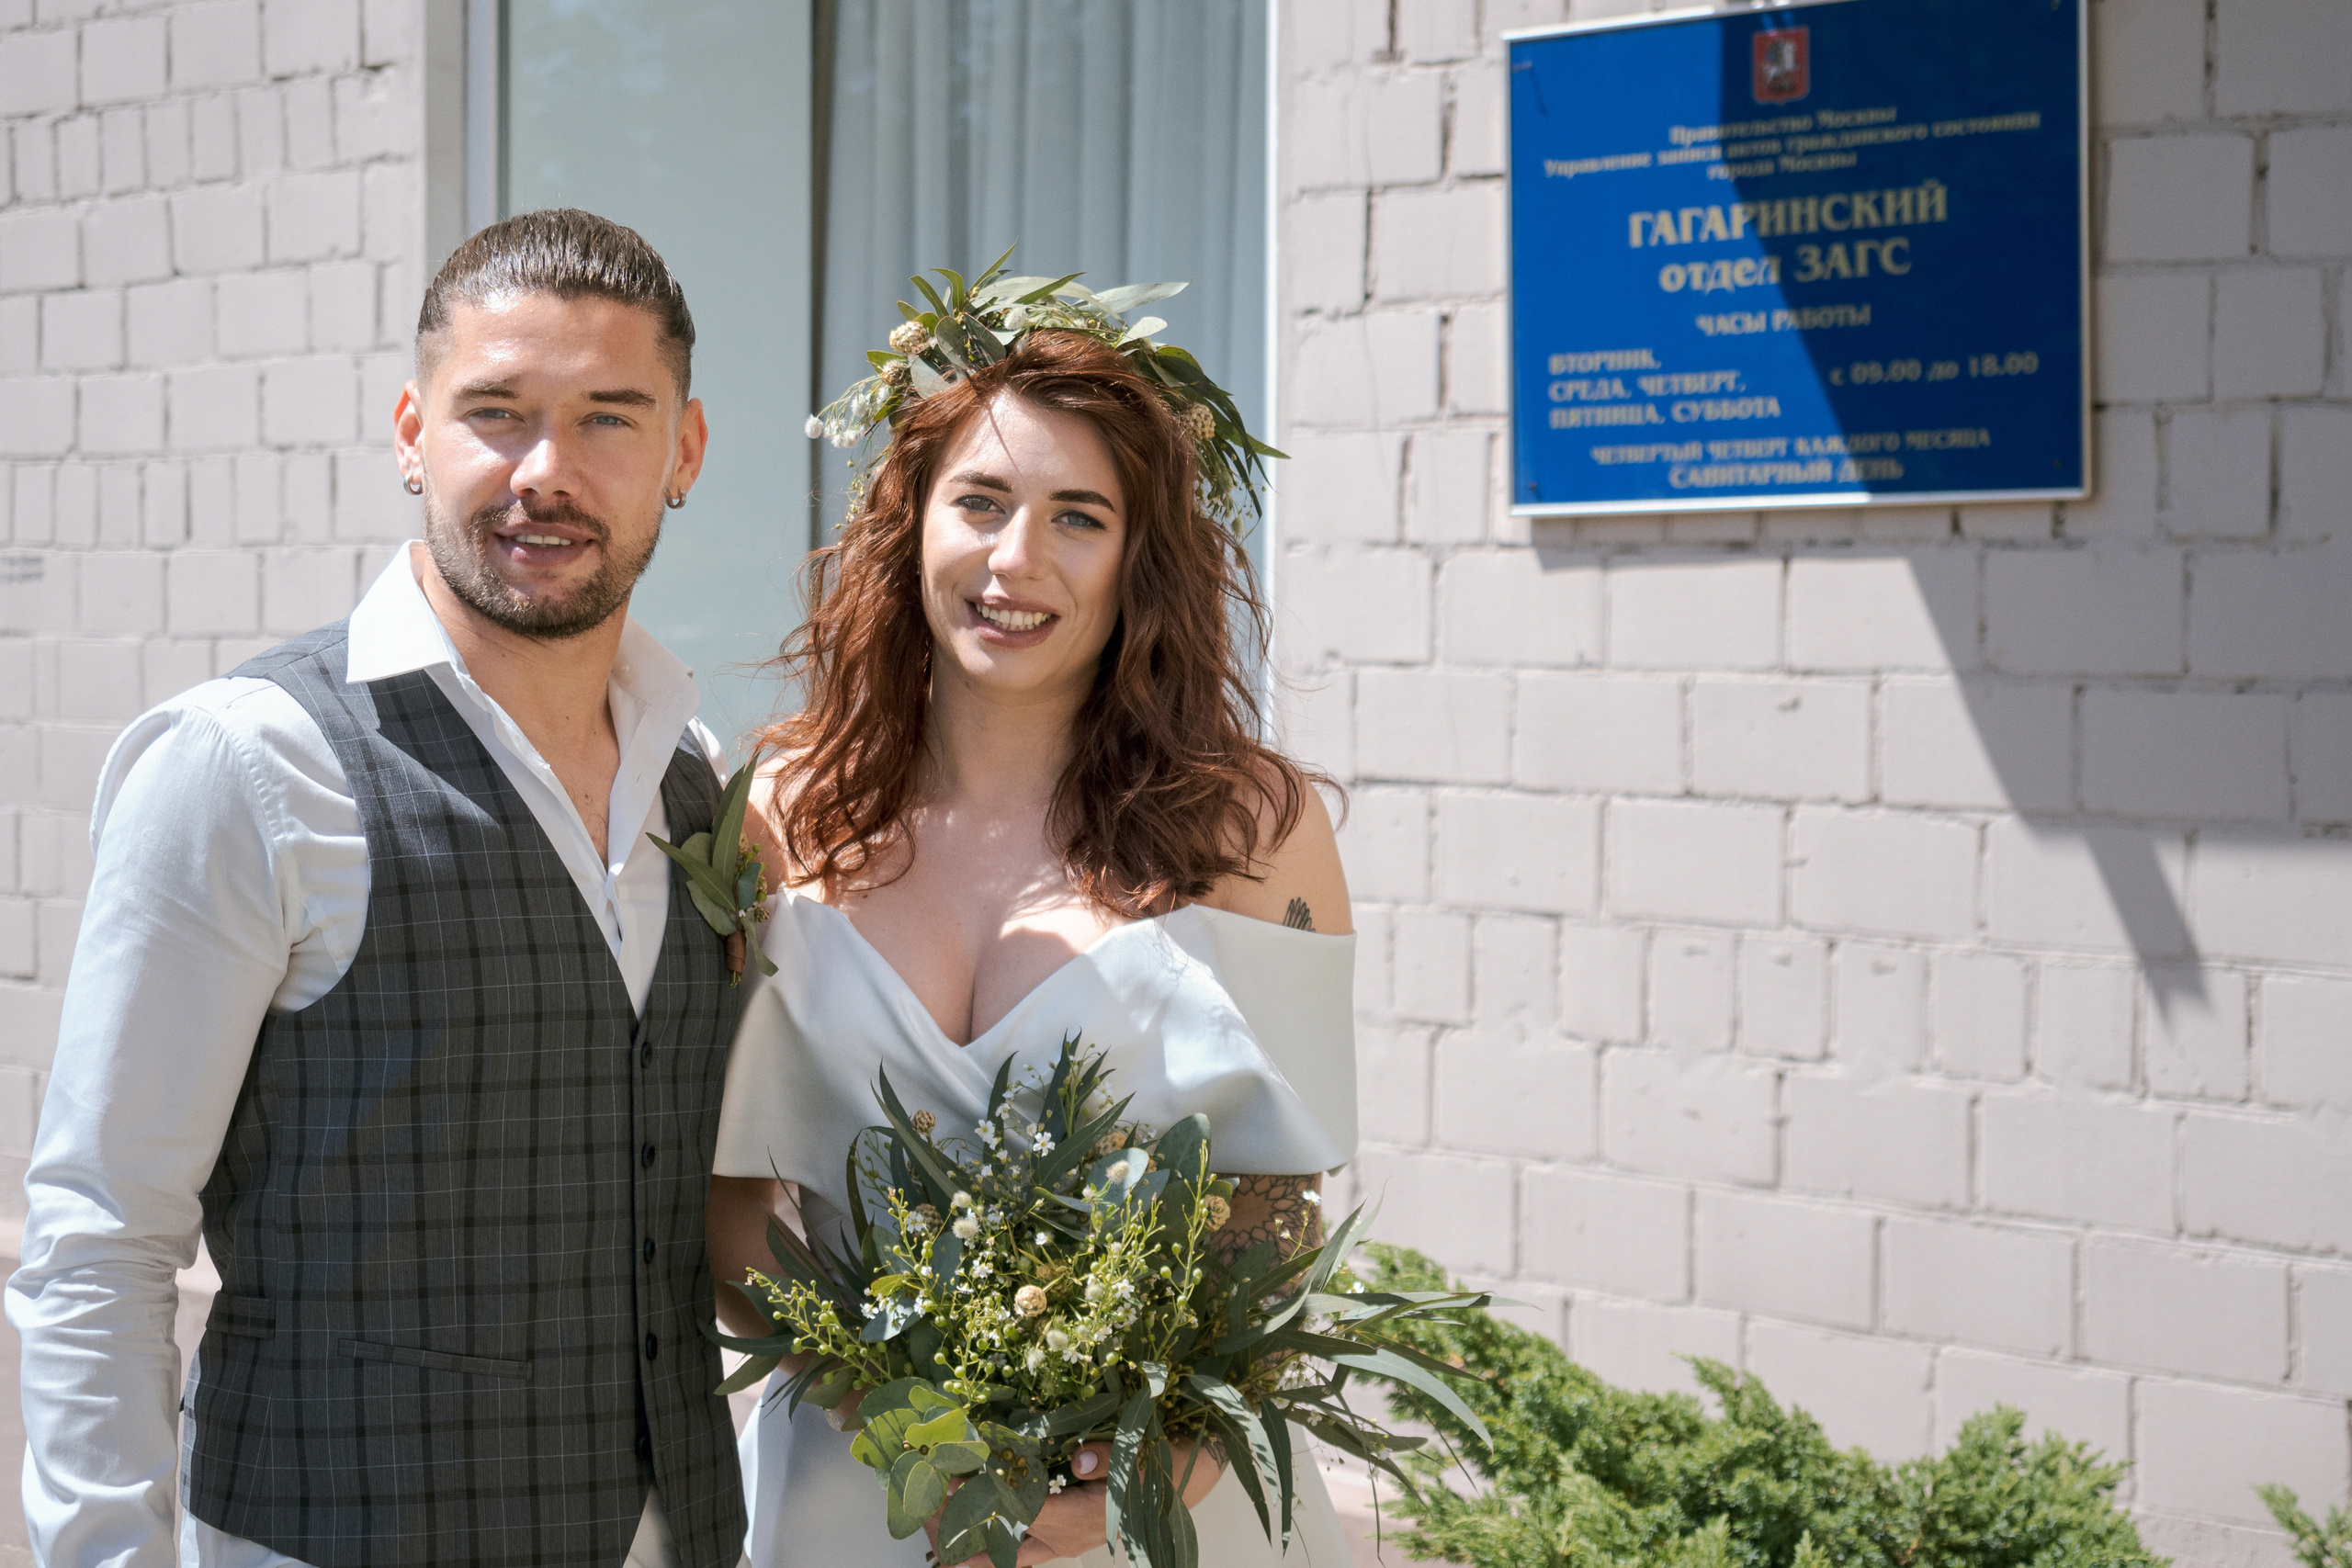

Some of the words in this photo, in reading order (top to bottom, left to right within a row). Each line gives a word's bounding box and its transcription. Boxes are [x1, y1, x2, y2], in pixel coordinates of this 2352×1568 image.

[1816, 106, 1897, 130] Москвы
[1544, 151, 1652, 179] Управление
[1657, 144, 1722, 166] записи
[1931, 111, 2041, 138] состояния
[1628, 179, 1949, 248] ГАГАРИНСКИЙ
[1658, 255, 1781, 295] отдел
[1794, 236, 1913, 283] ЗАГС
[1695, 311, 1767, 336] ЧАСЫ
[1771, 303, 1872, 332] РАБОТЫ
[1548, 348, 1661, 375] ВТОРНИК,
[1849, 358, 1922, 385] 09.00
[1926, 360, 1960, 382] до
[1968, 351, 2039, 378] 18.00
[1670, 396, 1781, 423] СУББОТА
[1707, 436, 1788, 459] ЧЕТВЕРГ
[1905, 427, 1992, 450] МЕСЯЦА
[1668, 458, 1833, 489] САНИТАРНЫЙ
[1838, 457, 1905, 483] ДЕНЬ
